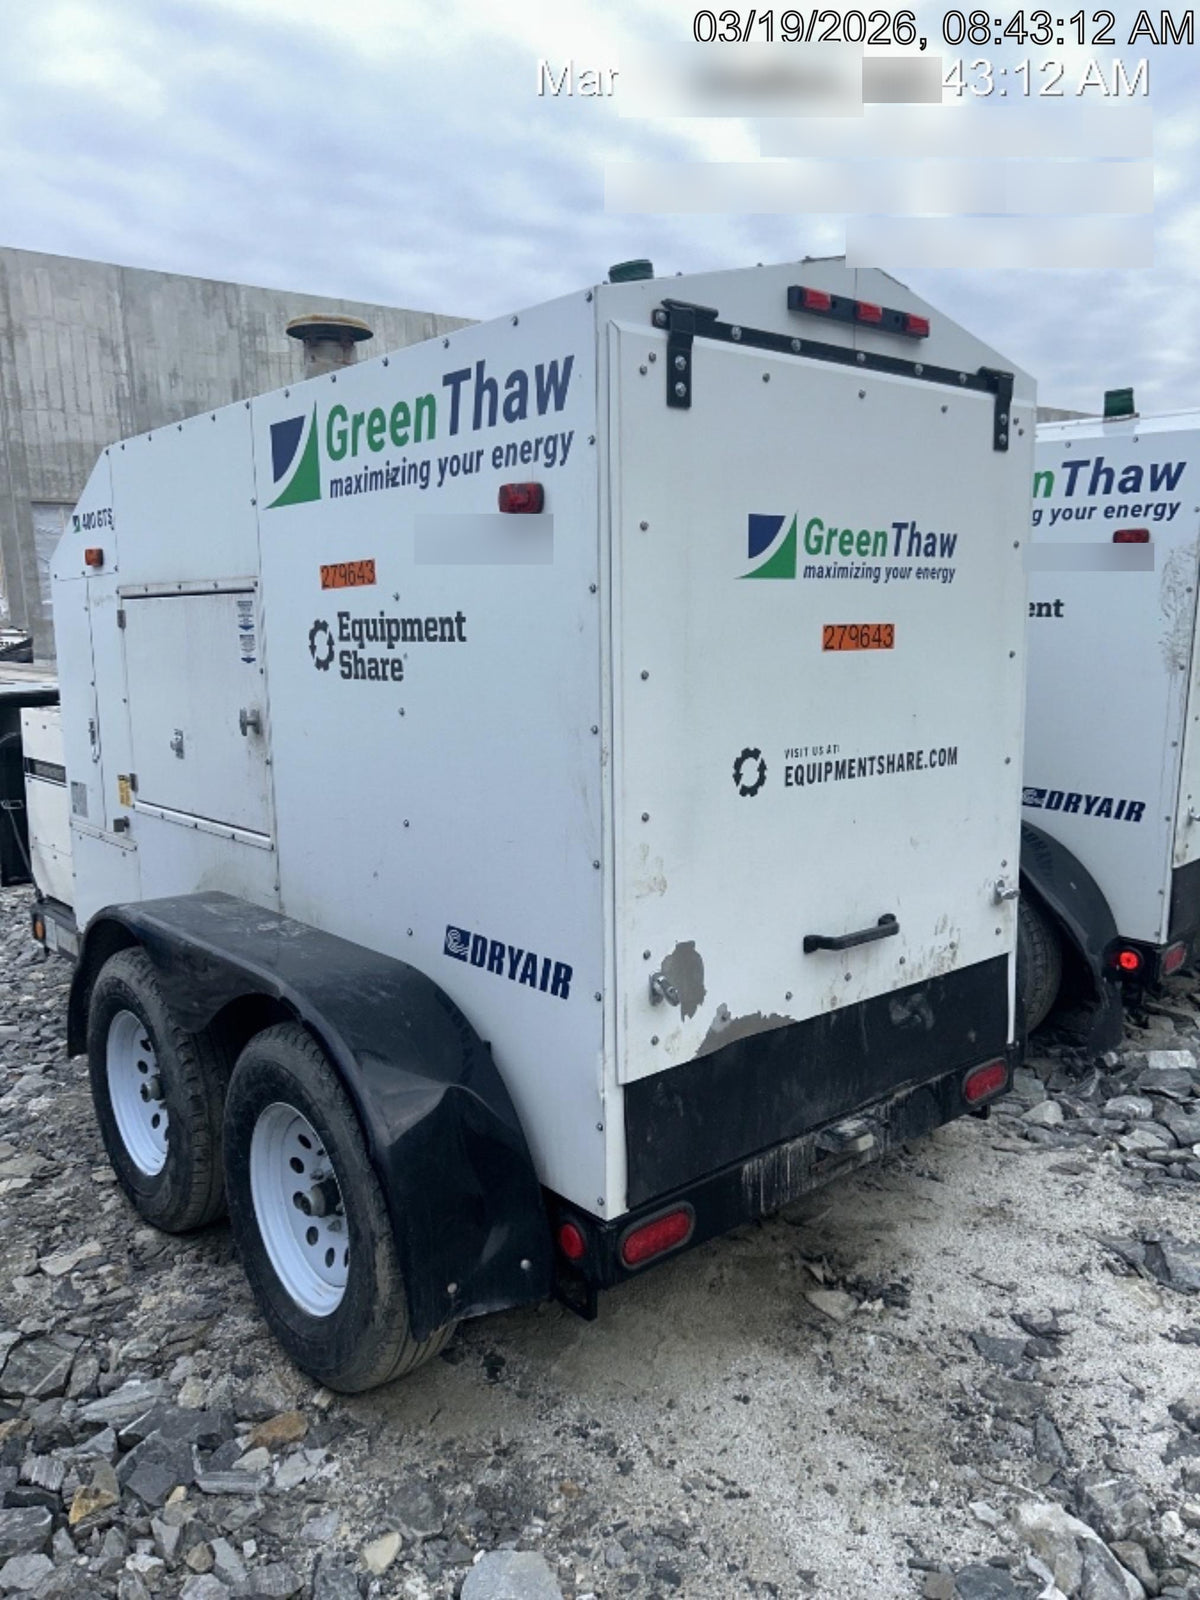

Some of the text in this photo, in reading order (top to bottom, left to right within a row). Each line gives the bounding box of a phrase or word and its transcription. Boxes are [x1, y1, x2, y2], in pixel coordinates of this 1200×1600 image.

[330, 430, 575, 499] maximizing your energy
[1049, 506, 1097, 527] your
[1103, 501, 1181, 522] energy
[321, 561, 376, 589] 279643
[803, 561, 956, 584] maximizing your energy
[337, 610, 467, 650] Equipment
[823, 624, 894, 650] 279643
[340, 650, 404, 683] Share
[784, 746, 808, 759] VISIT
[812, 745, 824, 757] US
[784, 746, 958, 788] EQUIPMENTSHARE.COM
[1045, 789, 1147, 822] DRYAIR
[470, 932, 573, 1000] DRYAIR
